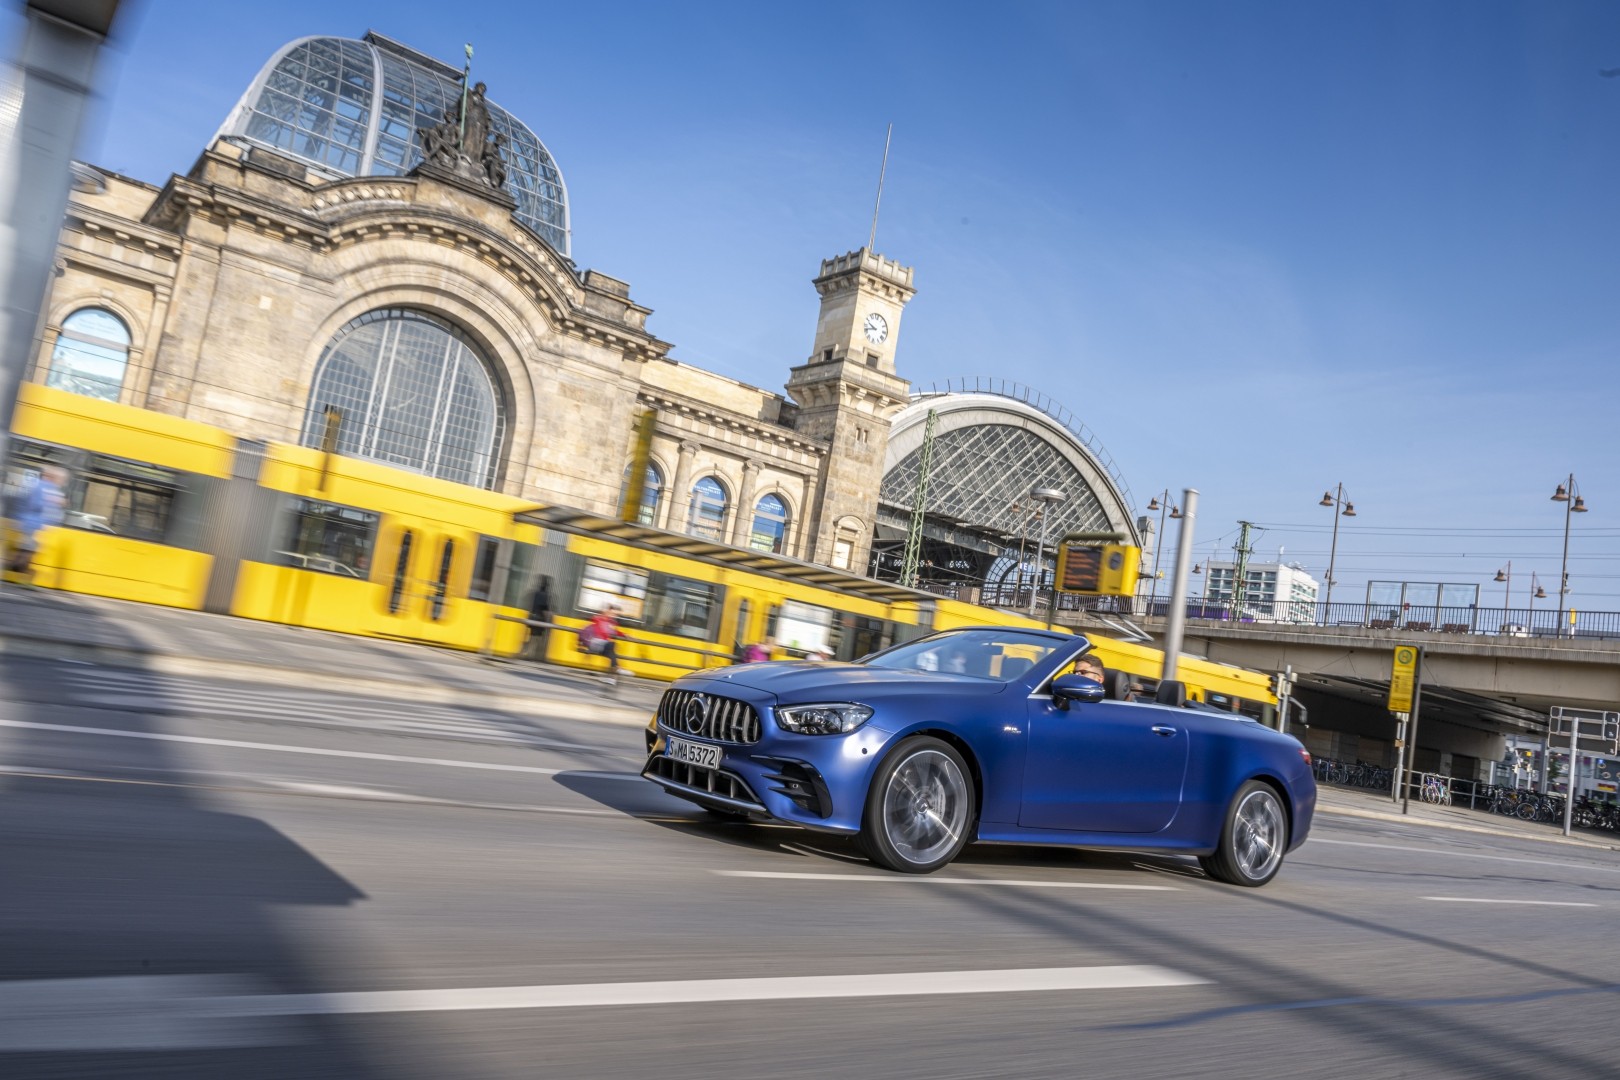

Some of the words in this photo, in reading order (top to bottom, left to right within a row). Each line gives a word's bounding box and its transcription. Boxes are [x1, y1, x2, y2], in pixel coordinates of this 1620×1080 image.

[669, 740, 675, 756] S
[677, 742, 688, 761] MA
[689, 745, 716, 767] 5372
